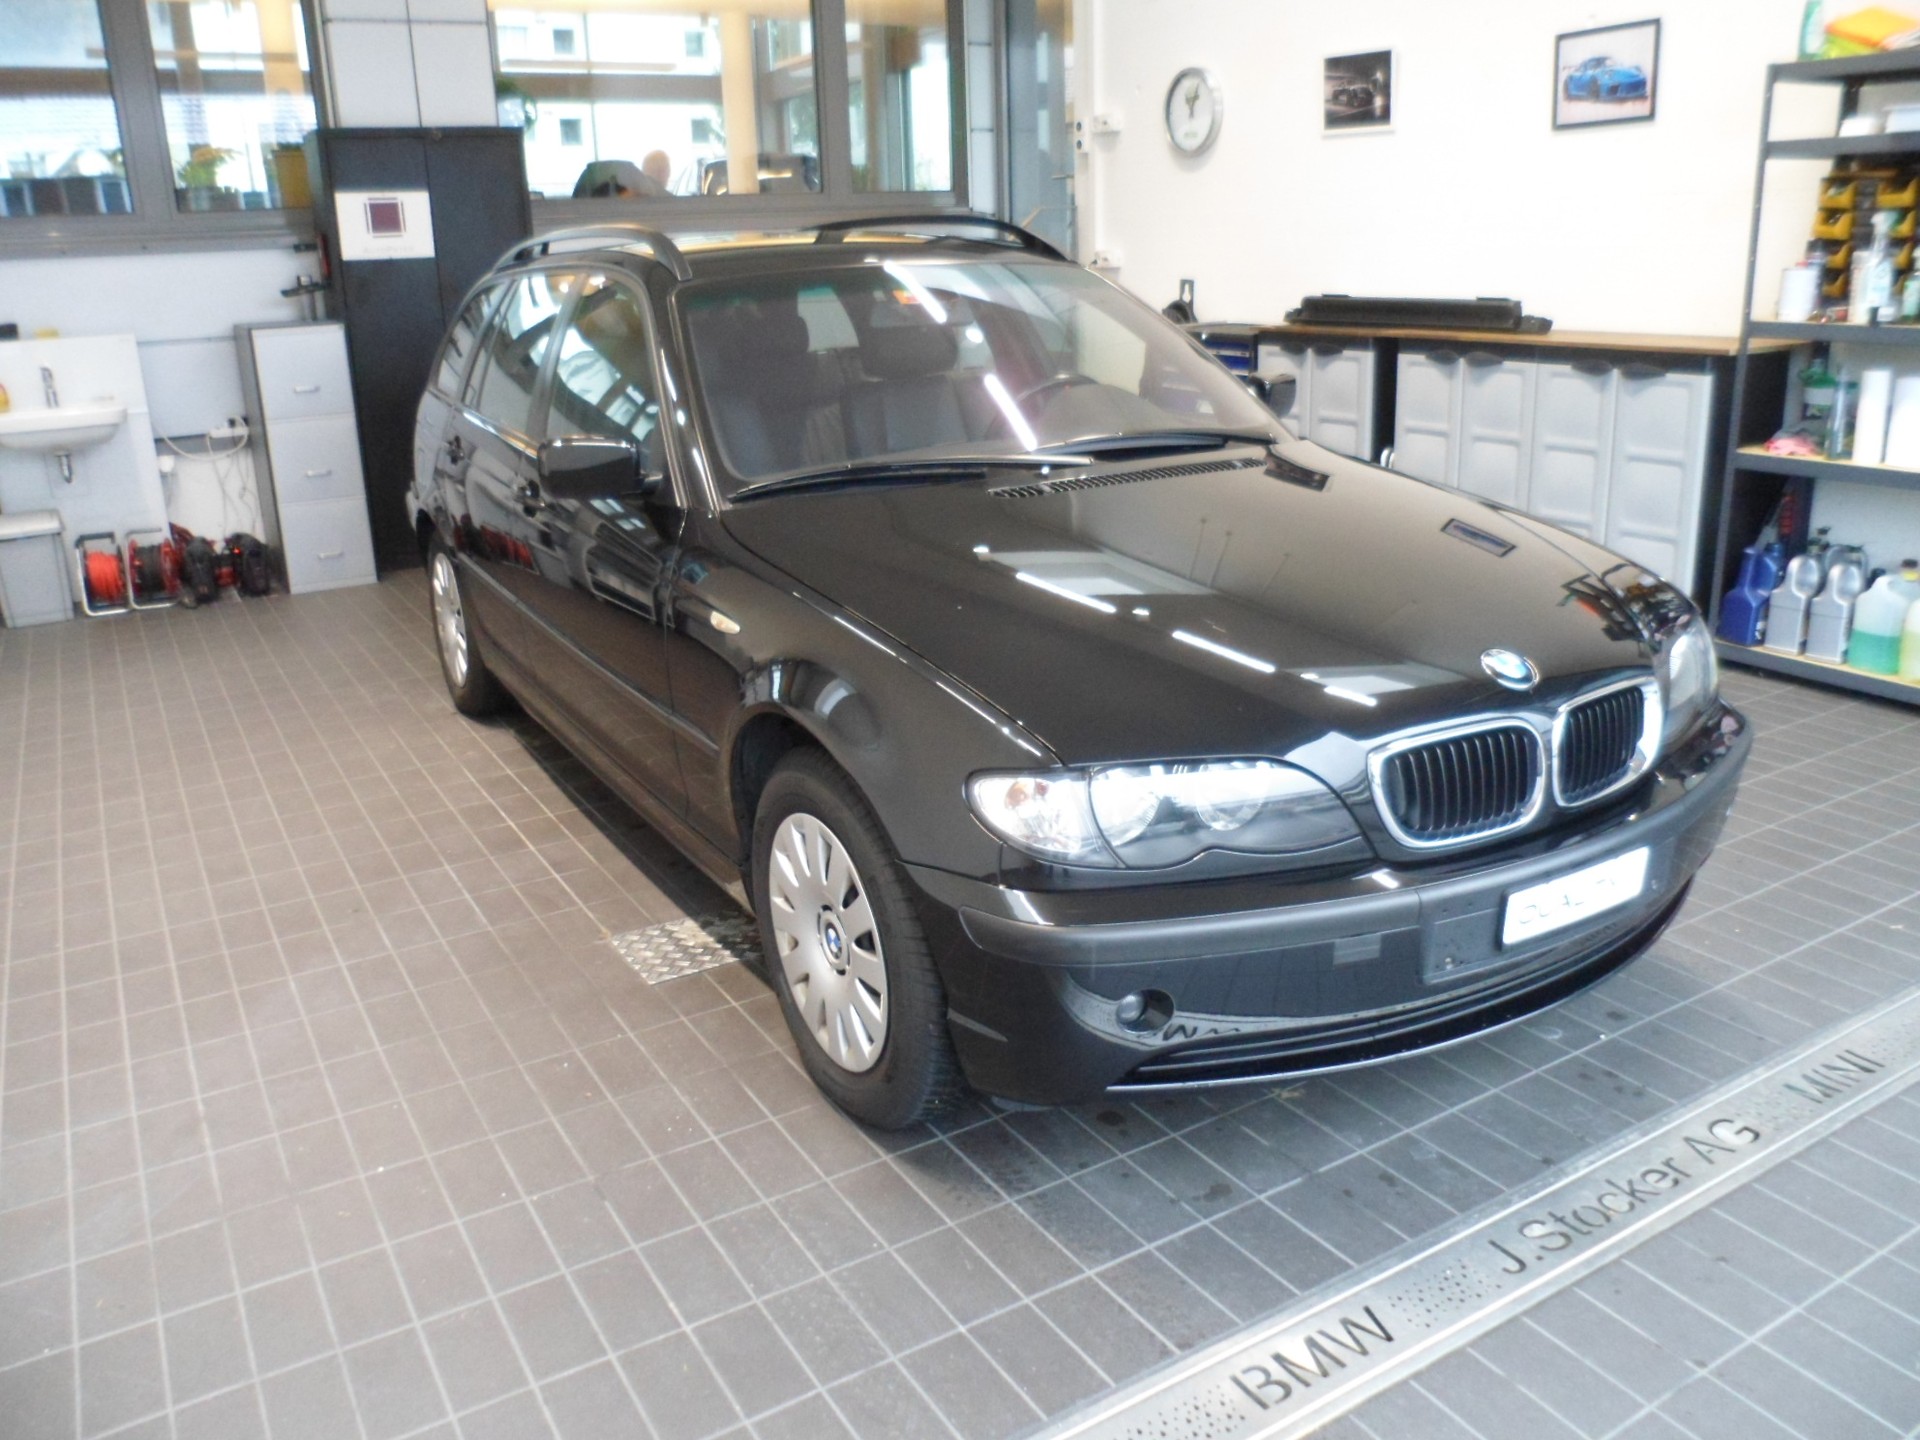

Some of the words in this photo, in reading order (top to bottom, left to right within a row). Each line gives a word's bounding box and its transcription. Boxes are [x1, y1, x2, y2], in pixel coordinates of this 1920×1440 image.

[1230, 1305, 1394, 1410] BMW
[1488, 1156, 1692, 1274] J.Stocker
[1683, 1118, 1761, 1165] AG
[1783, 1048, 1887, 1104] MINI
